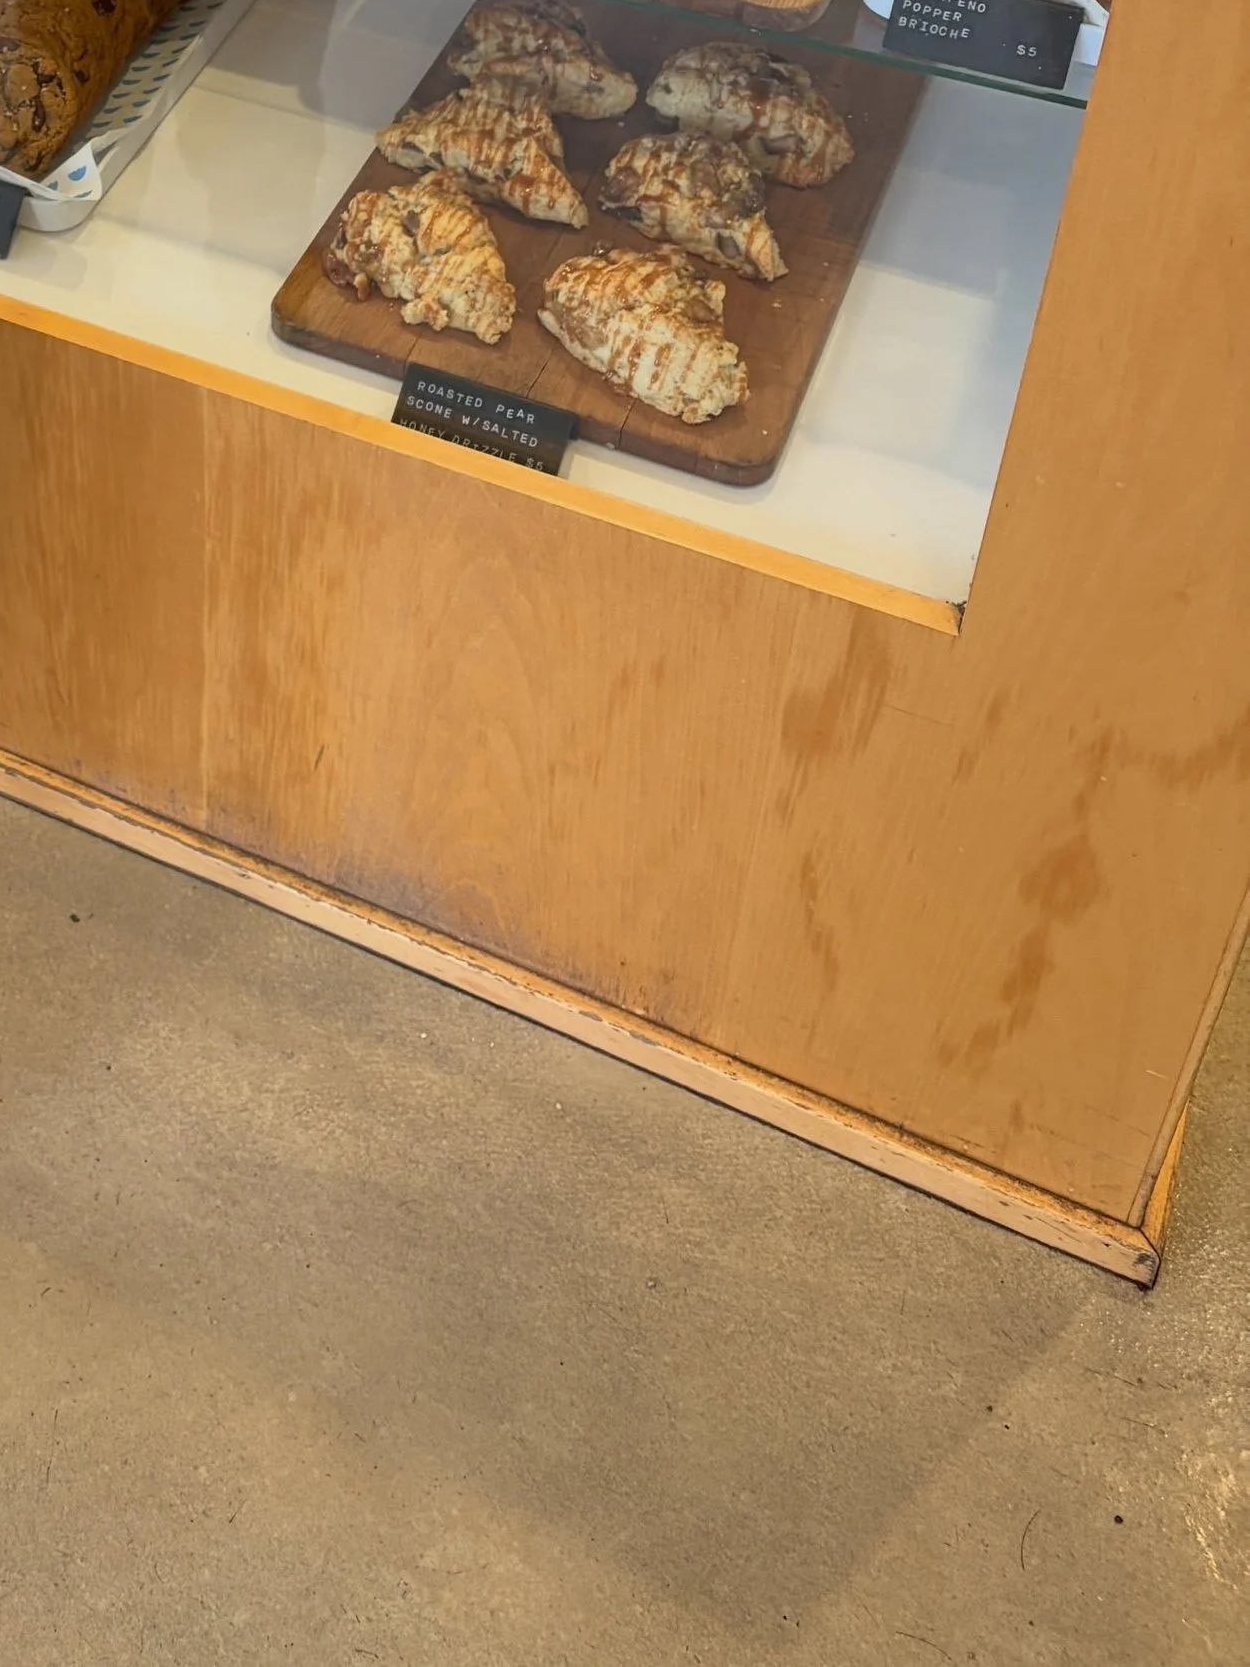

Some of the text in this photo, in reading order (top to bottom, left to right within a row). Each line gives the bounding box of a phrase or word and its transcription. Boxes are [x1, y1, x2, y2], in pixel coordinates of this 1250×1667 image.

[898, 16, 971, 40] BRIOCHE
[903, 0, 963, 23] POPPER
[417, 381, 536, 425] ROASTED PEAR
[407, 395, 539, 448] SCONE W/SALTED
